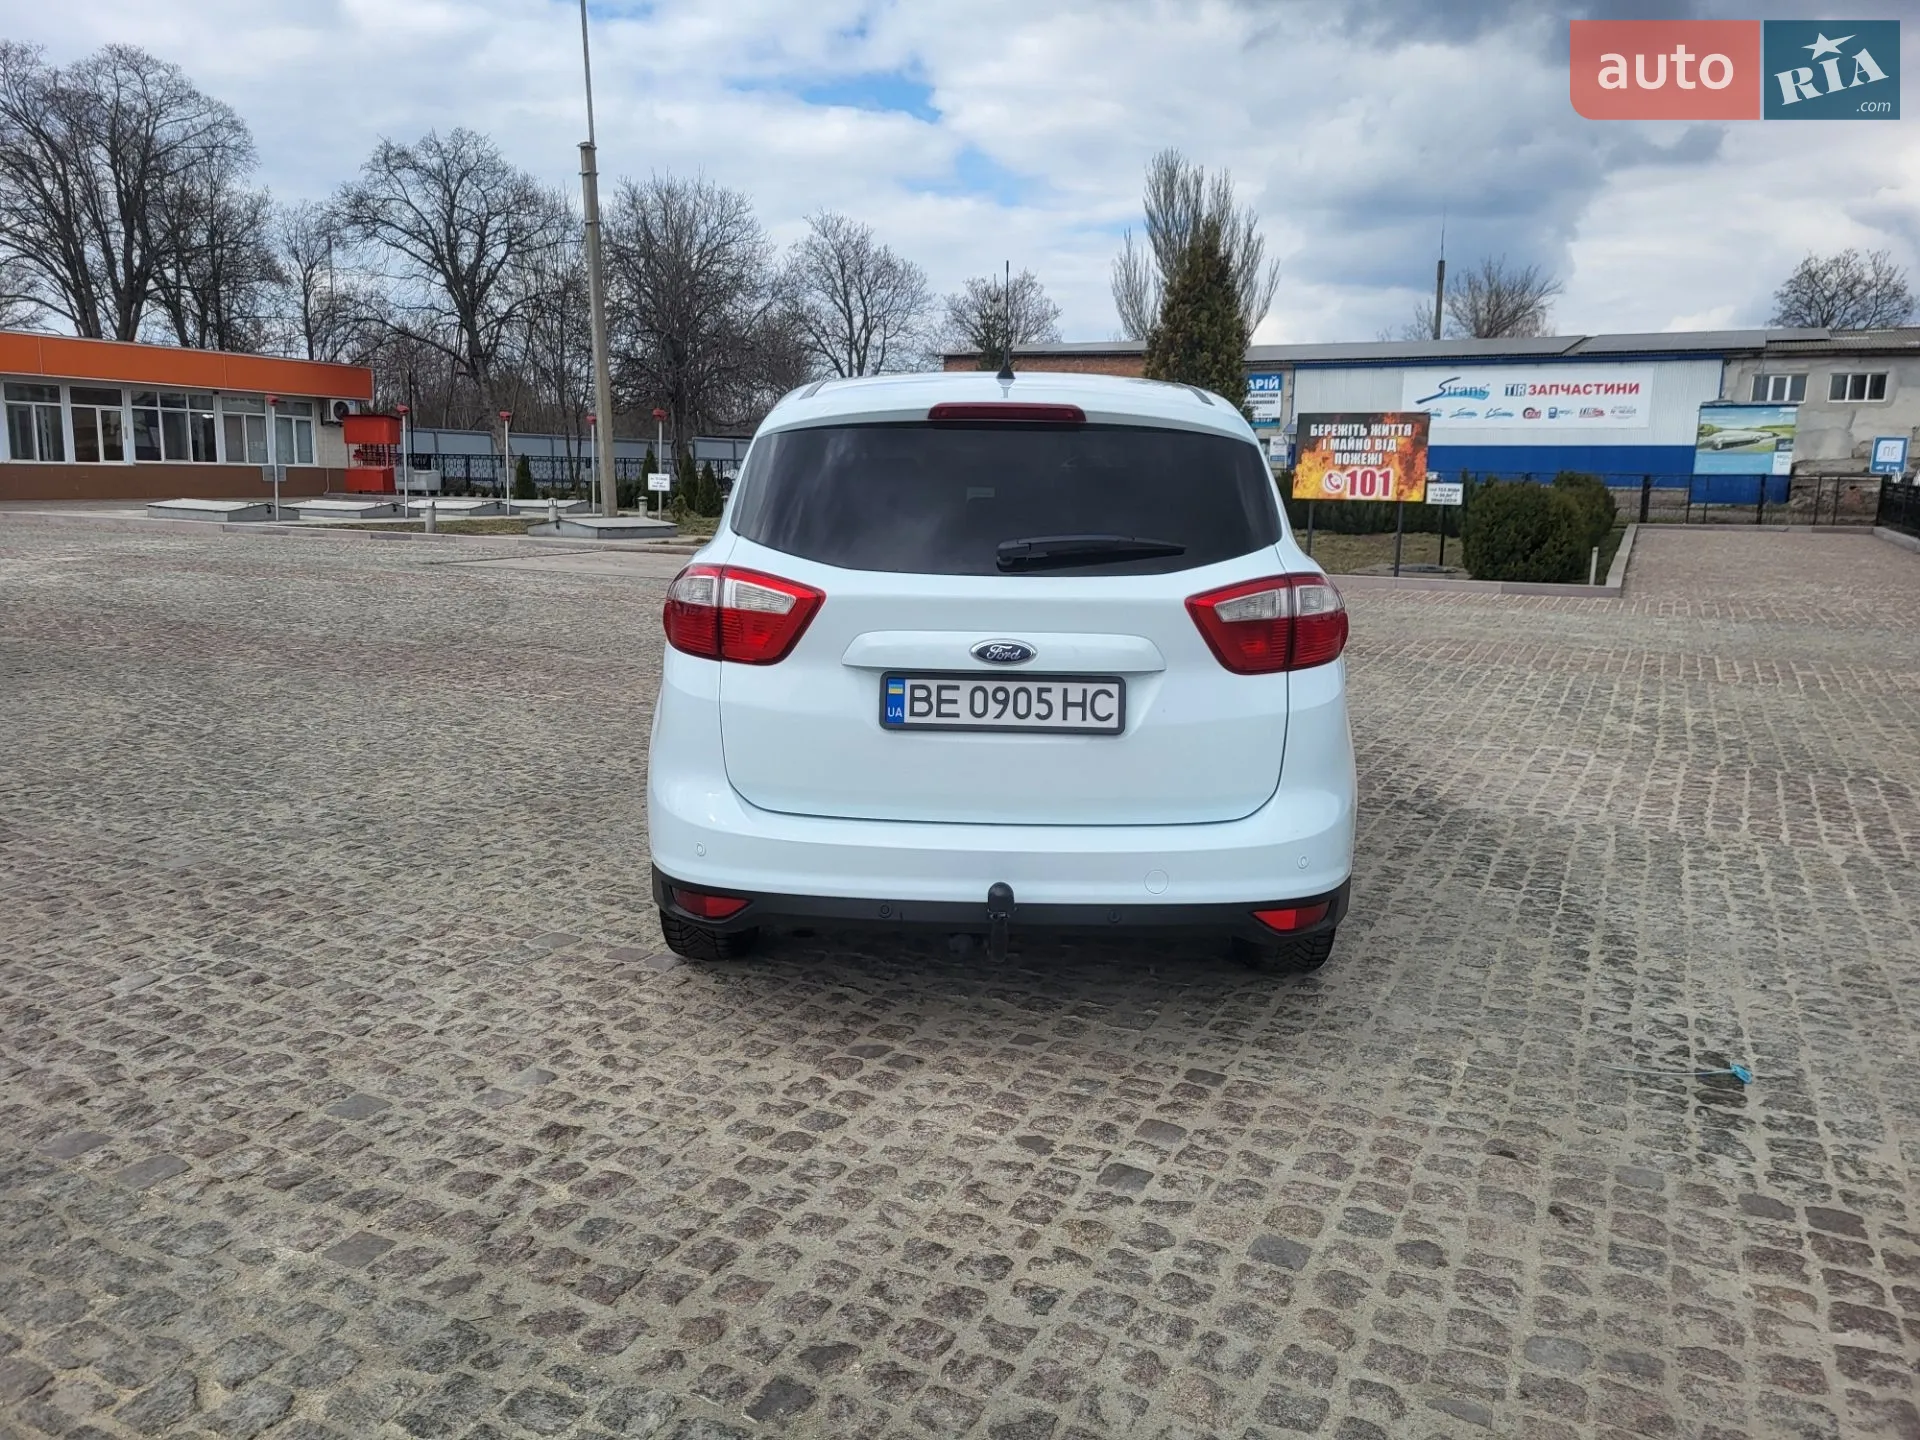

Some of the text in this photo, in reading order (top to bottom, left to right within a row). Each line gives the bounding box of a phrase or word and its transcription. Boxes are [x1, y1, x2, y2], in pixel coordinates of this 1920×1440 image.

[1528, 382, 1641, 397] ЗАПЧАСТИНИ
[1310, 423, 1412, 437] БЕРЕЖІТЬ ЖИТТЯ
[1322, 437, 1397, 452] І МАЙНО ВІД
[1334, 452, 1383, 465] ПОЖЕЖІ
[1346, 469, 1391, 497] 101
[986, 644, 1021, 661] Ford
[909, 684, 1114, 721] BE 0905 HC
[887, 707, 903, 718] UA
